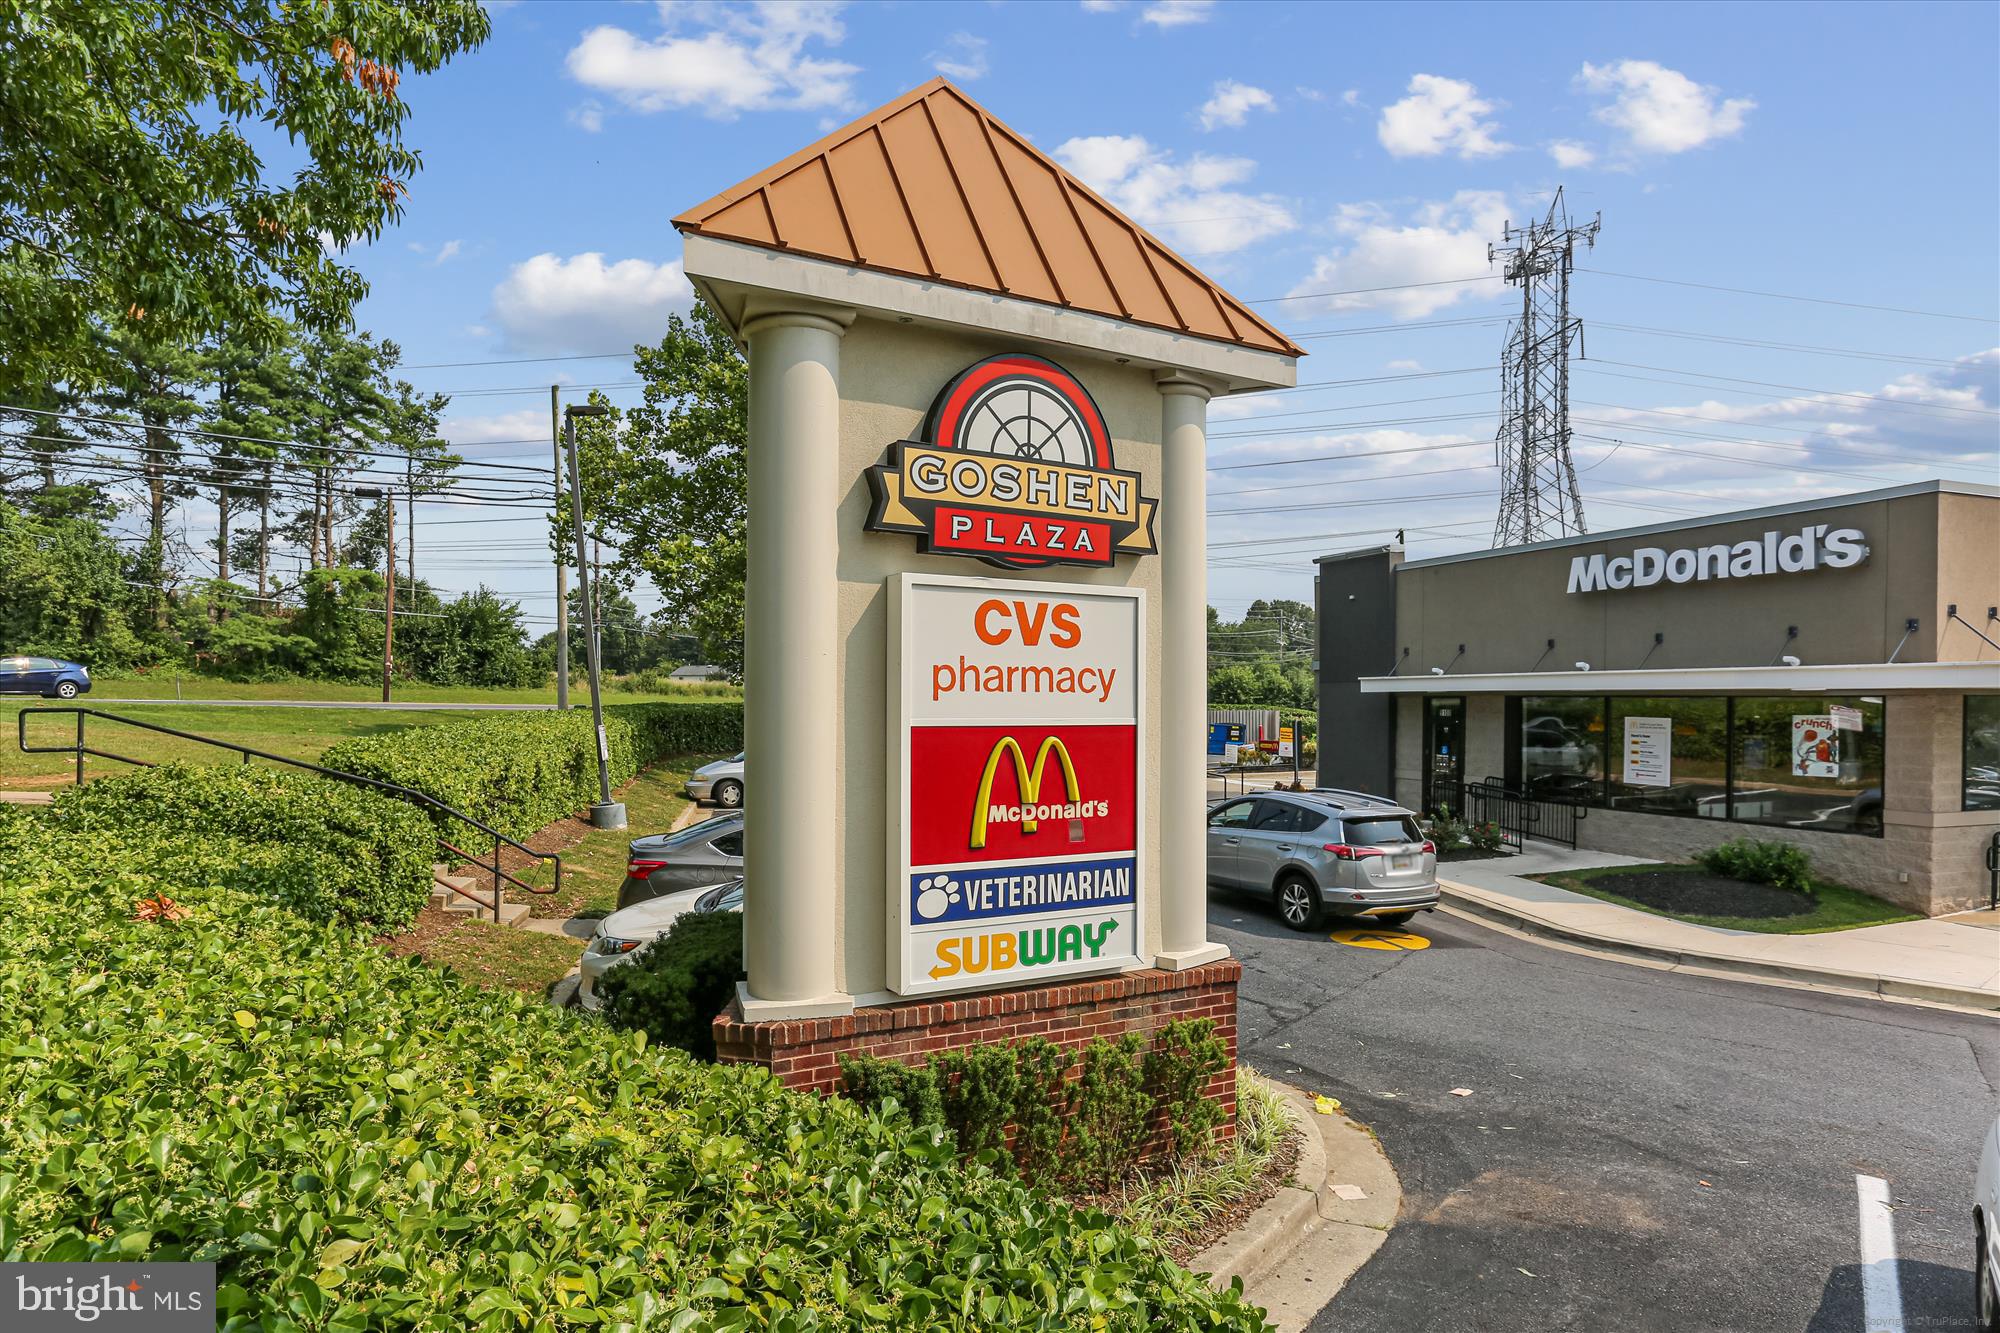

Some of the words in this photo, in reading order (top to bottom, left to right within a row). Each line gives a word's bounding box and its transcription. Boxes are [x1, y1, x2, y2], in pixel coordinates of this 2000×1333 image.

[909, 453, 1129, 515] GOSHEN
[951, 515, 1095, 552] PLAZA
[1566, 525, 1866, 594] McDonald's
[974, 599, 1082, 648] CVS
[932, 656, 1116, 702] pharmacy
[988, 800, 1109, 823] McDonald's
[964, 867, 1131, 911] VETERINARIAN
[928, 917, 1119, 981] SUBWAY
